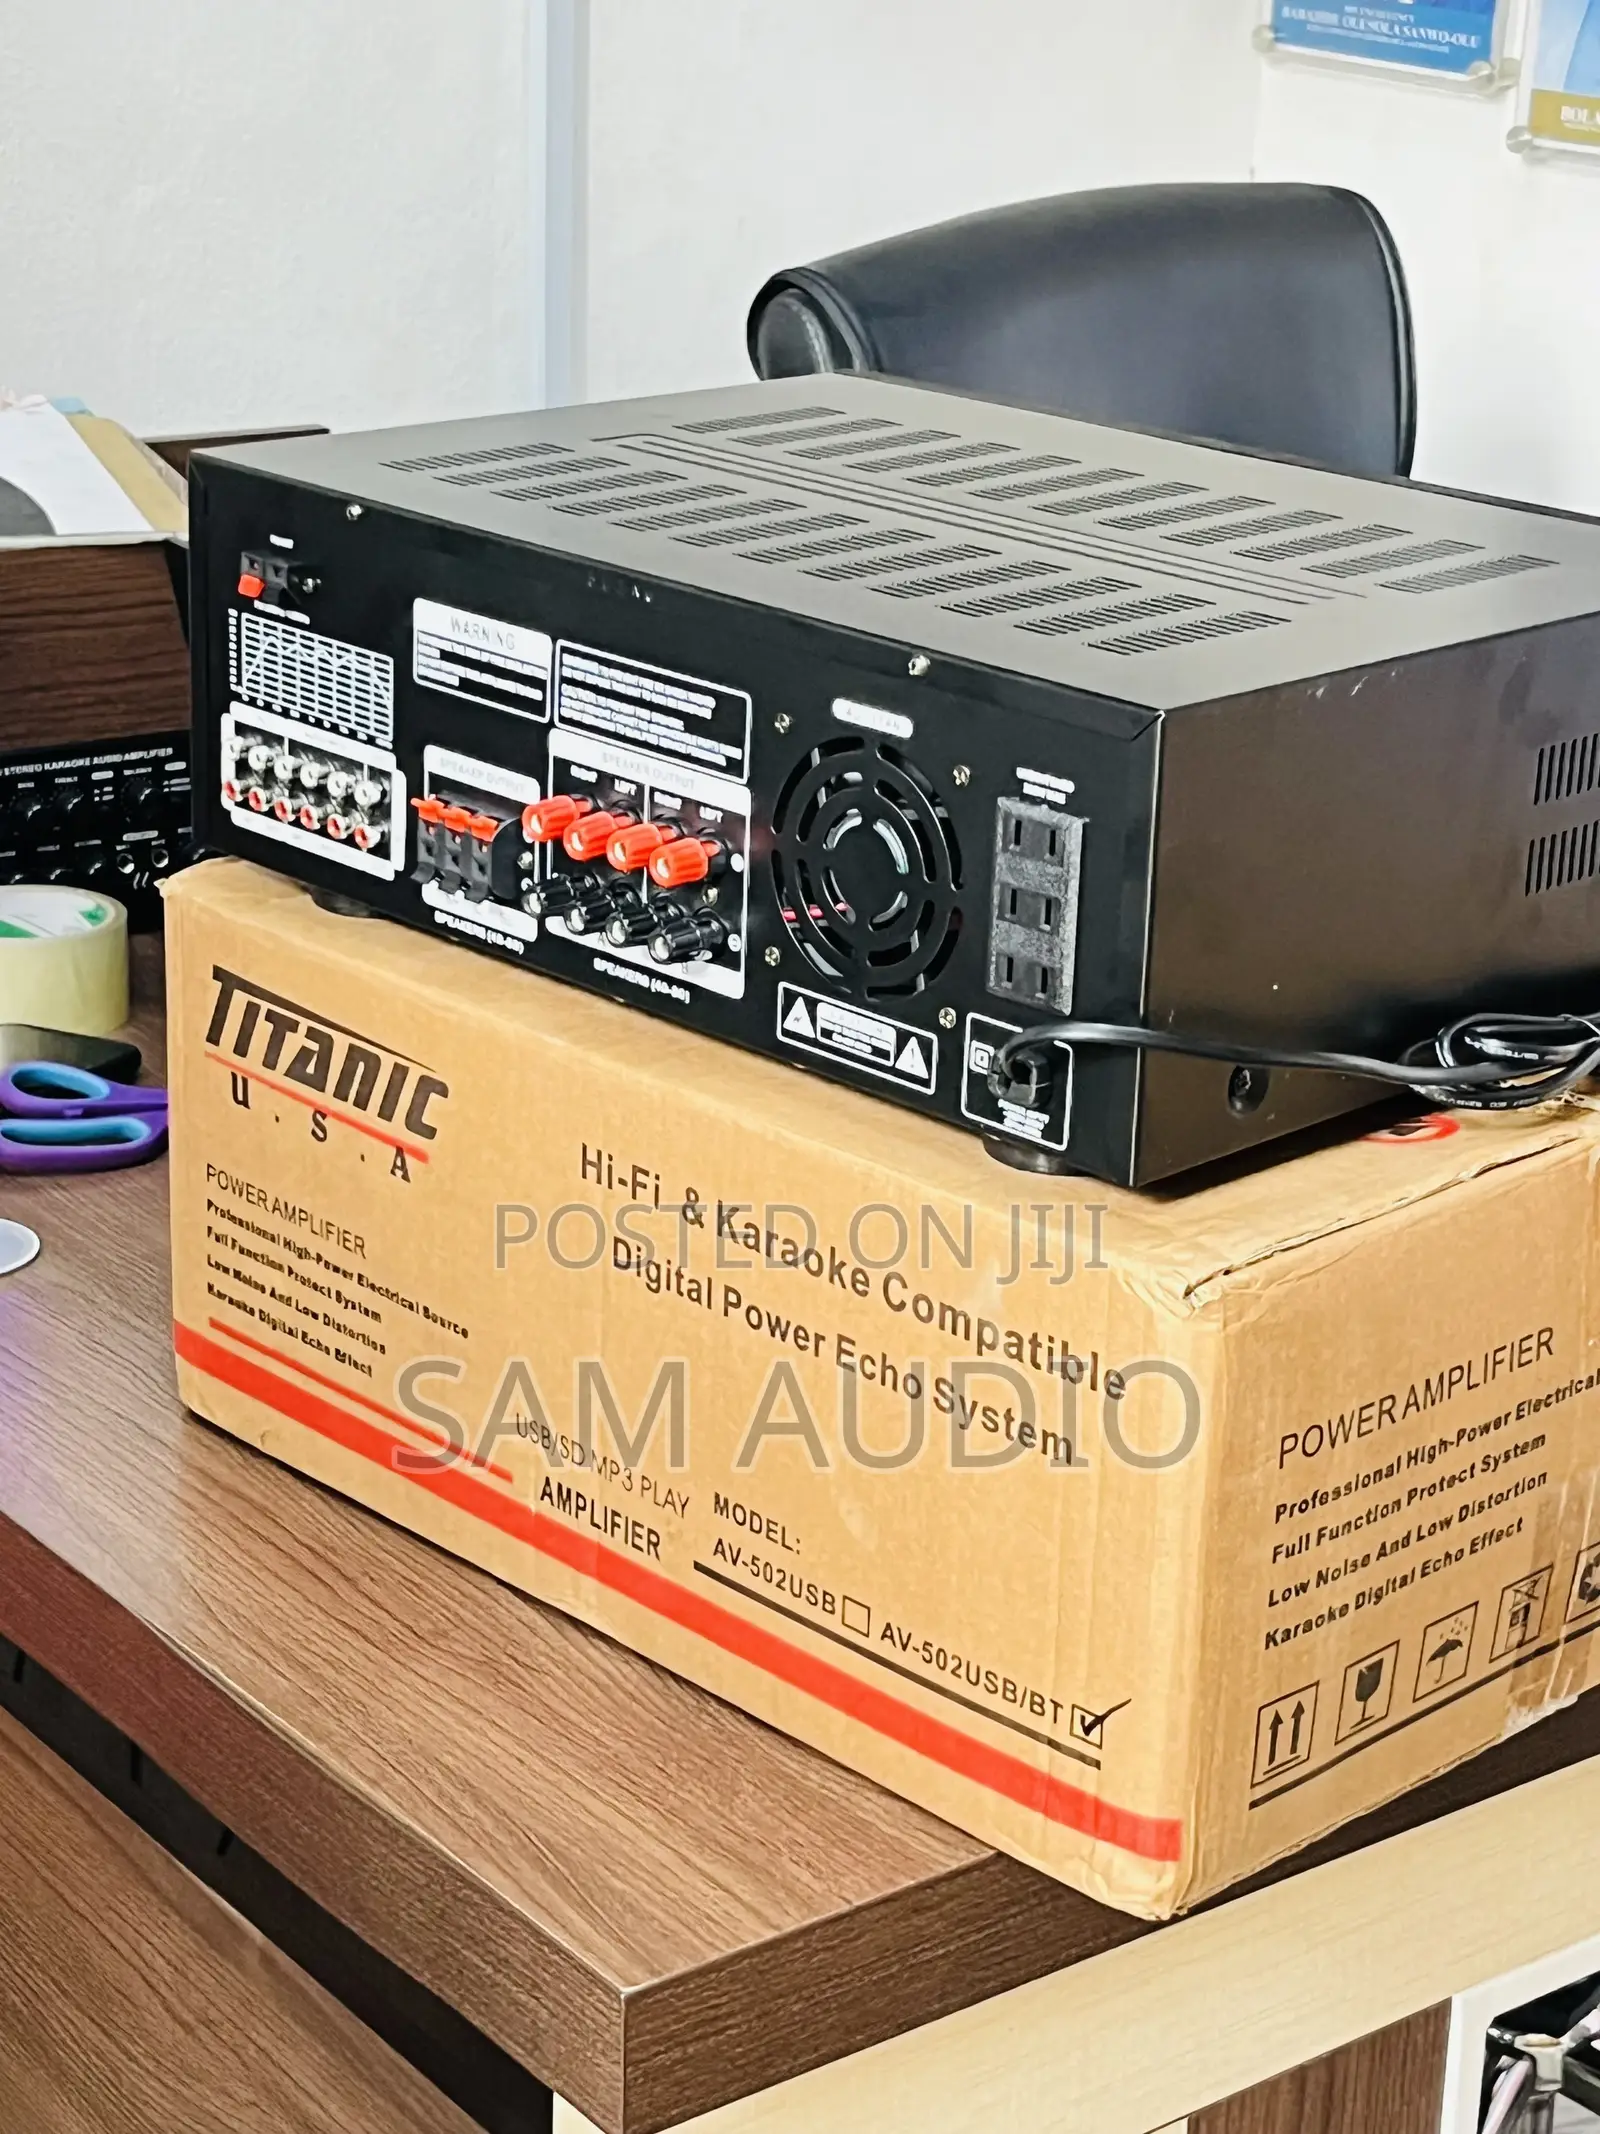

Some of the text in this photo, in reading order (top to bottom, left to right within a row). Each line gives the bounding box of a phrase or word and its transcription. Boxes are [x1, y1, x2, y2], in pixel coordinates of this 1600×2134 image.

[44, 757, 91, 770] KARAOKE
[92, 753, 122, 765] AUDIO
[206, 1162, 367, 1260] POWER AMPLIFIER
[580, 1141, 1127, 1401] Hi-Fi & Karaoke Compatible
[287, 1264, 333, 1300] Protect
[334, 1289, 383, 1324] System
[294, 1298, 320, 1322] Low
[356, 1272, 420, 1316] Electrical
[612, 1235, 1073, 1466] Digital Power Echo System
[1274, 1367, 1600, 1525] Professional High-Power Electrical
[1278, 1326, 1555, 1470] POWER AMPLIFIER
[515, 1412, 586, 1468] USB/SD
[640, 1474, 691, 1520] PLAY
[540, 1475, 661, 1562] AMPLIFIER
[713, 1491, 801, 1556] MODEL:
[1271, 1432, 1547, 1565] Full Function Protect System
[1264, 1515, 1525, 1651] Karaoke Digital Echo Effect
[1267, 1470, 1549, 1608] Low Noise And Low Distortion
[712, 1537, 1065, 1726] AV-502USB AV-502USB/BT
